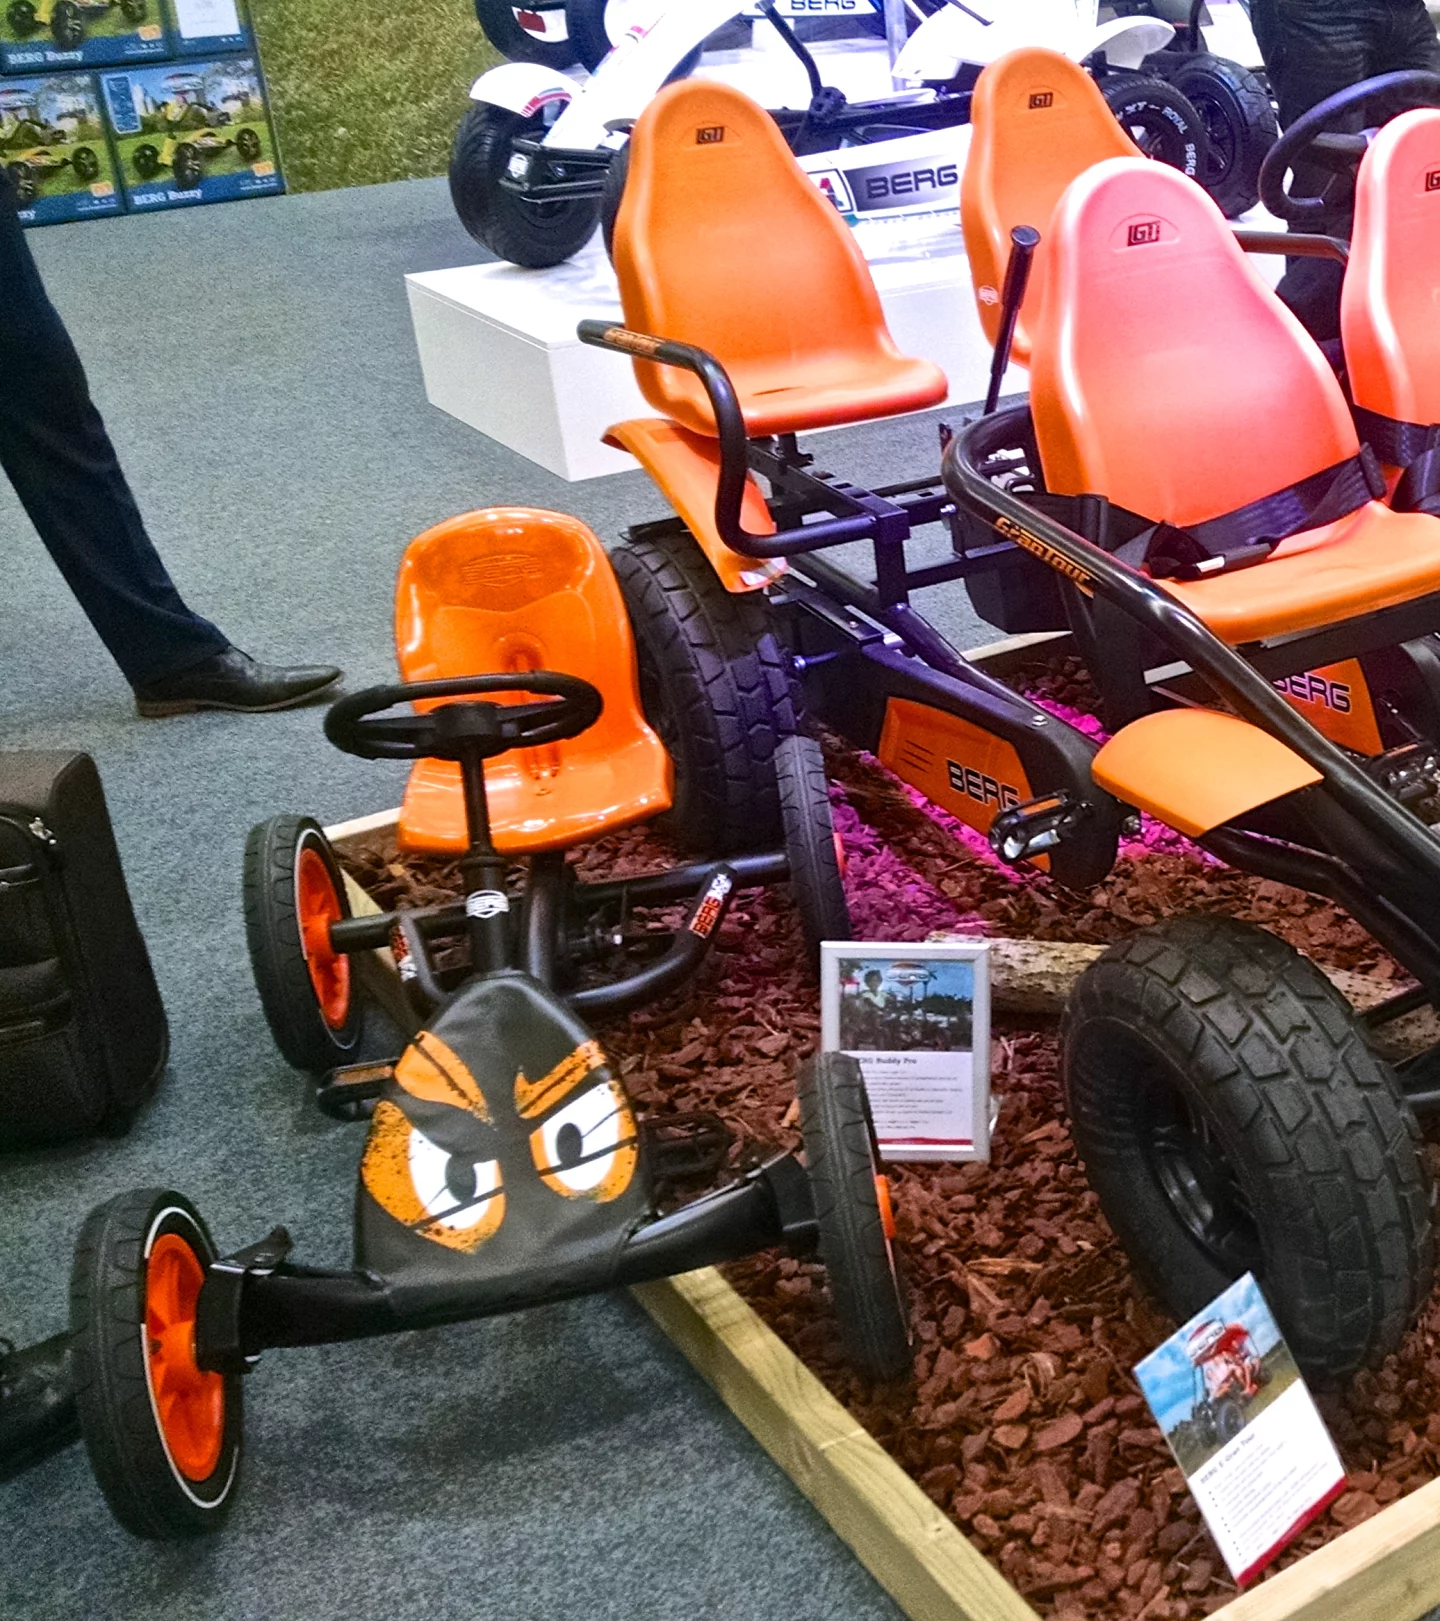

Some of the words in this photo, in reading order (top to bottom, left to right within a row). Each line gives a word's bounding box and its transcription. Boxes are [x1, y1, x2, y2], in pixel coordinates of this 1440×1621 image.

[1184, 142, 1197, 176] BERG
[866, 164, 959, 199] BERG
[946, 758, 1021, 812] BERG
